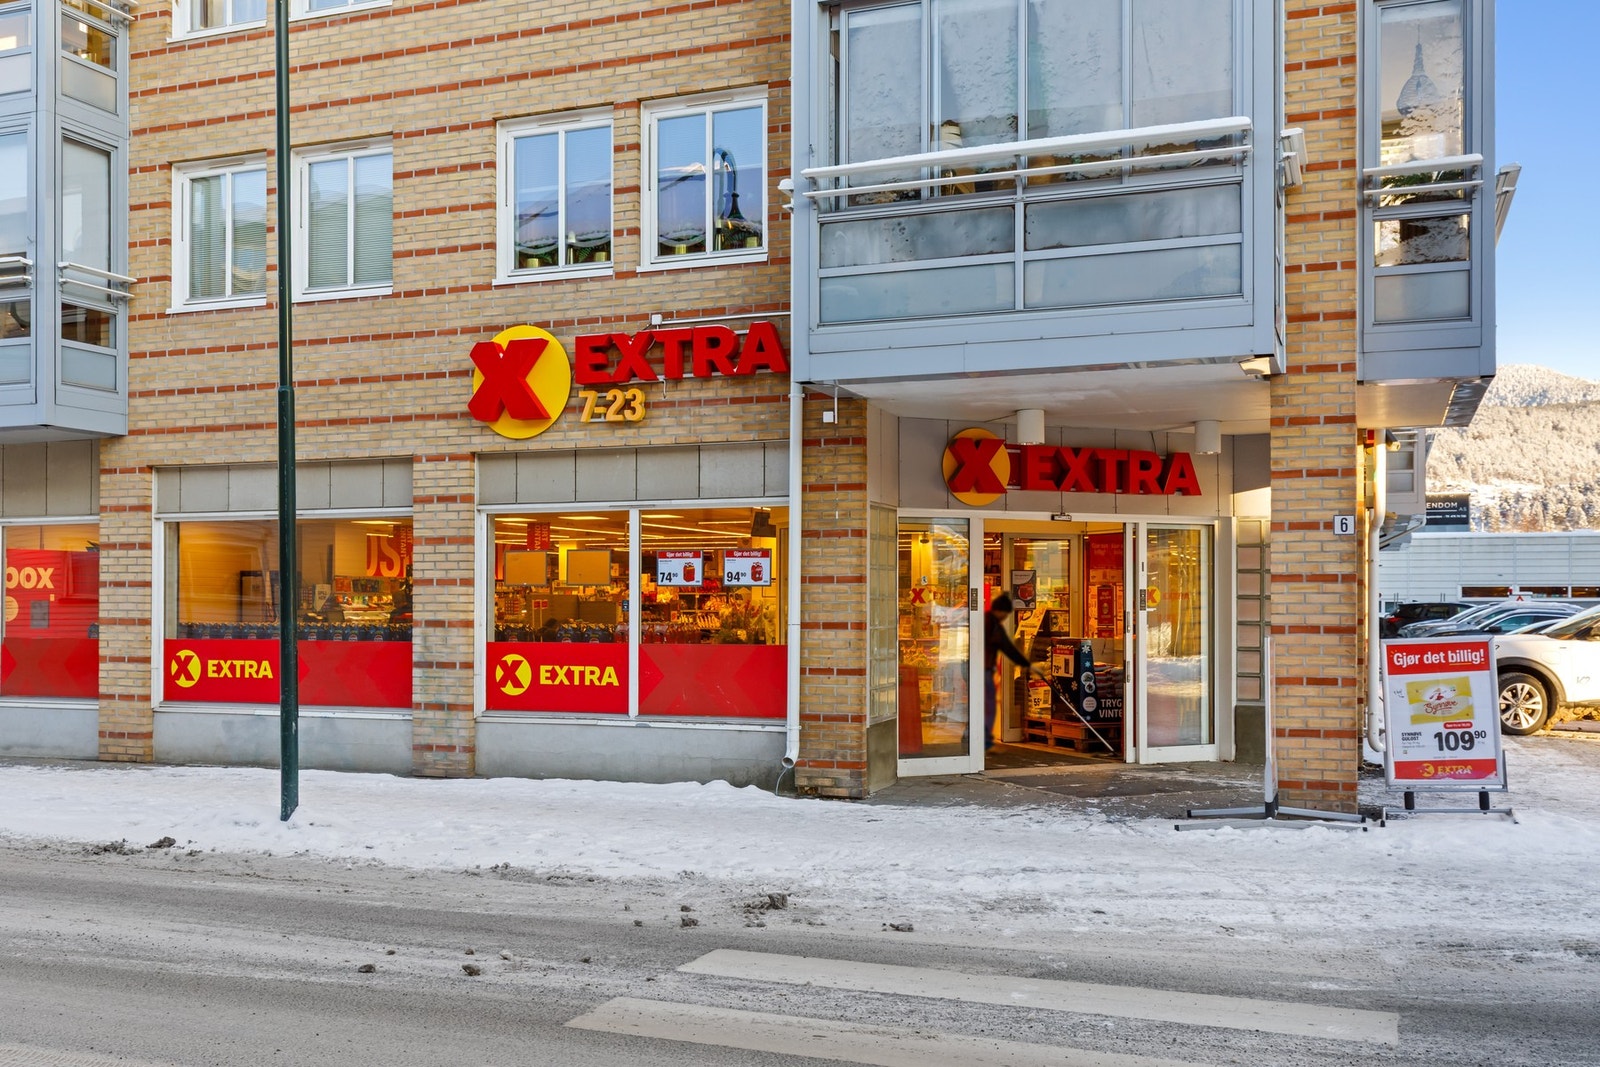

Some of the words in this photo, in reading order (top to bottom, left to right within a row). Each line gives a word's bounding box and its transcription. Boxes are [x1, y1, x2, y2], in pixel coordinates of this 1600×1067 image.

[574, 321, 788, 385] EXTRA
[578, 388, 646, 423] 7-23
[1022, 445, 1202, 496] EXTRA
[1340, 517, 1348, 532] 6
[659, 572, 672, 583] 74
[726, 571, 741, 582] 94
[1393, 652, 1421, 668] Gjør
[1423, 651, 1445, 664] det
[1448, 649, 1485, 665] billig!
[207, 660, 274, 679] EXTRA
[539, 665, 620, 686] EXTRA
[1433, 730, 1475, 751] 109
[1474, 730, 1487, 739] 90
